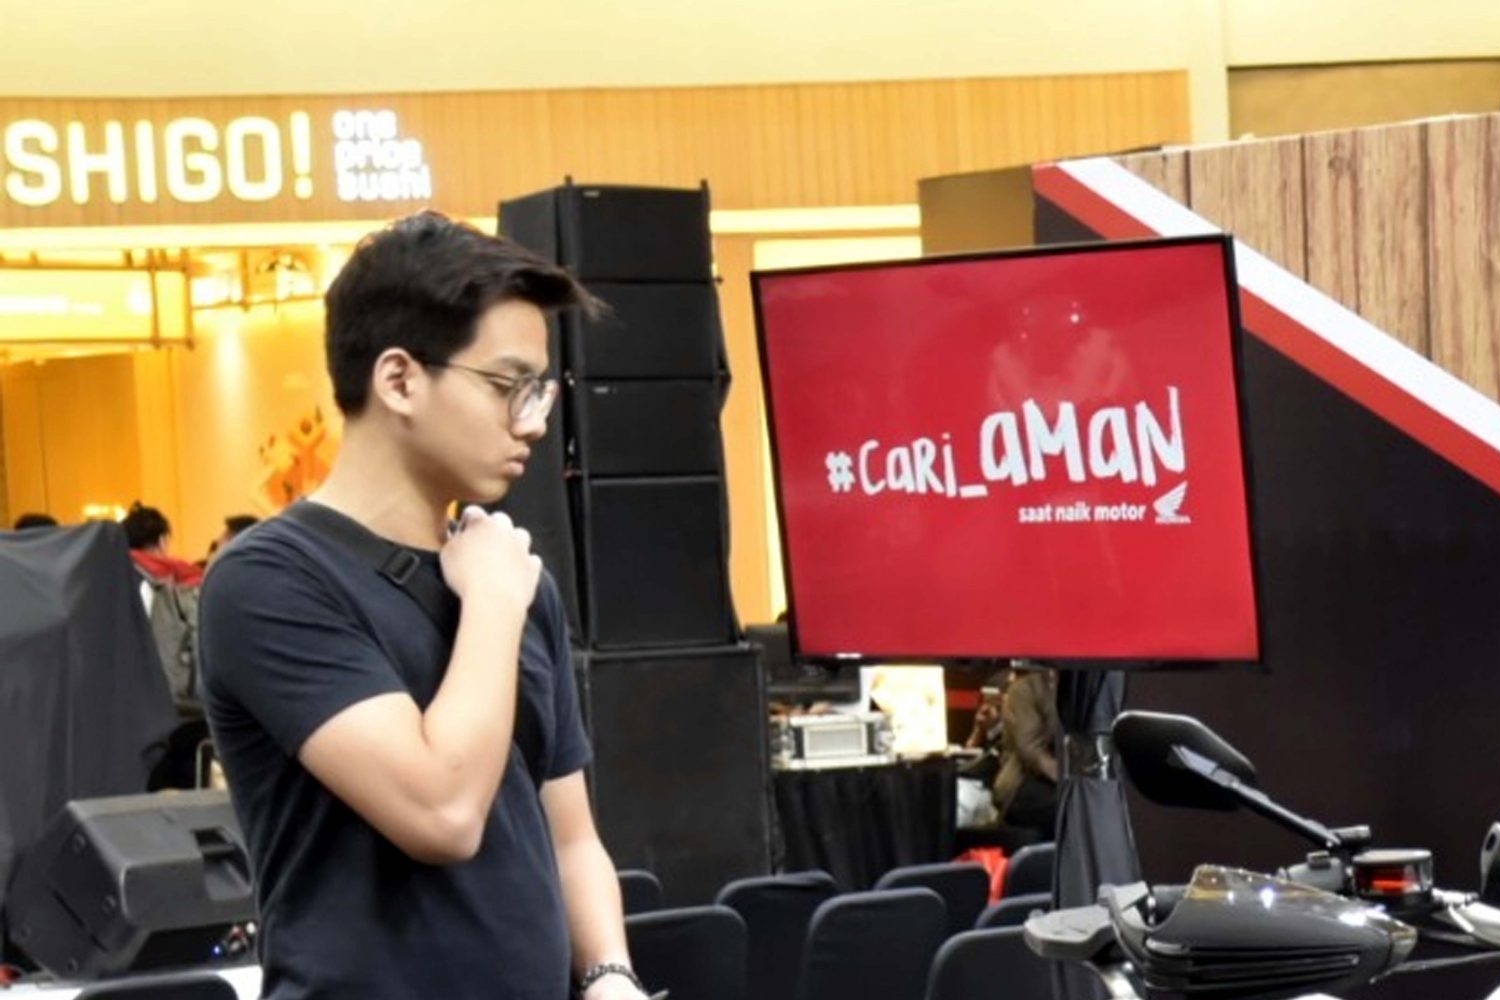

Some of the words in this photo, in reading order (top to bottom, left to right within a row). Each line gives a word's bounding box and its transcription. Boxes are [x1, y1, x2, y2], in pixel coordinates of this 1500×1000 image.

[3, 110, 314, 207] SHIGO!
[1018, 504, 1052, 523] saat
[1055, 501, 1091, 522] naik
[1094, 502, 1147, 521] motor
